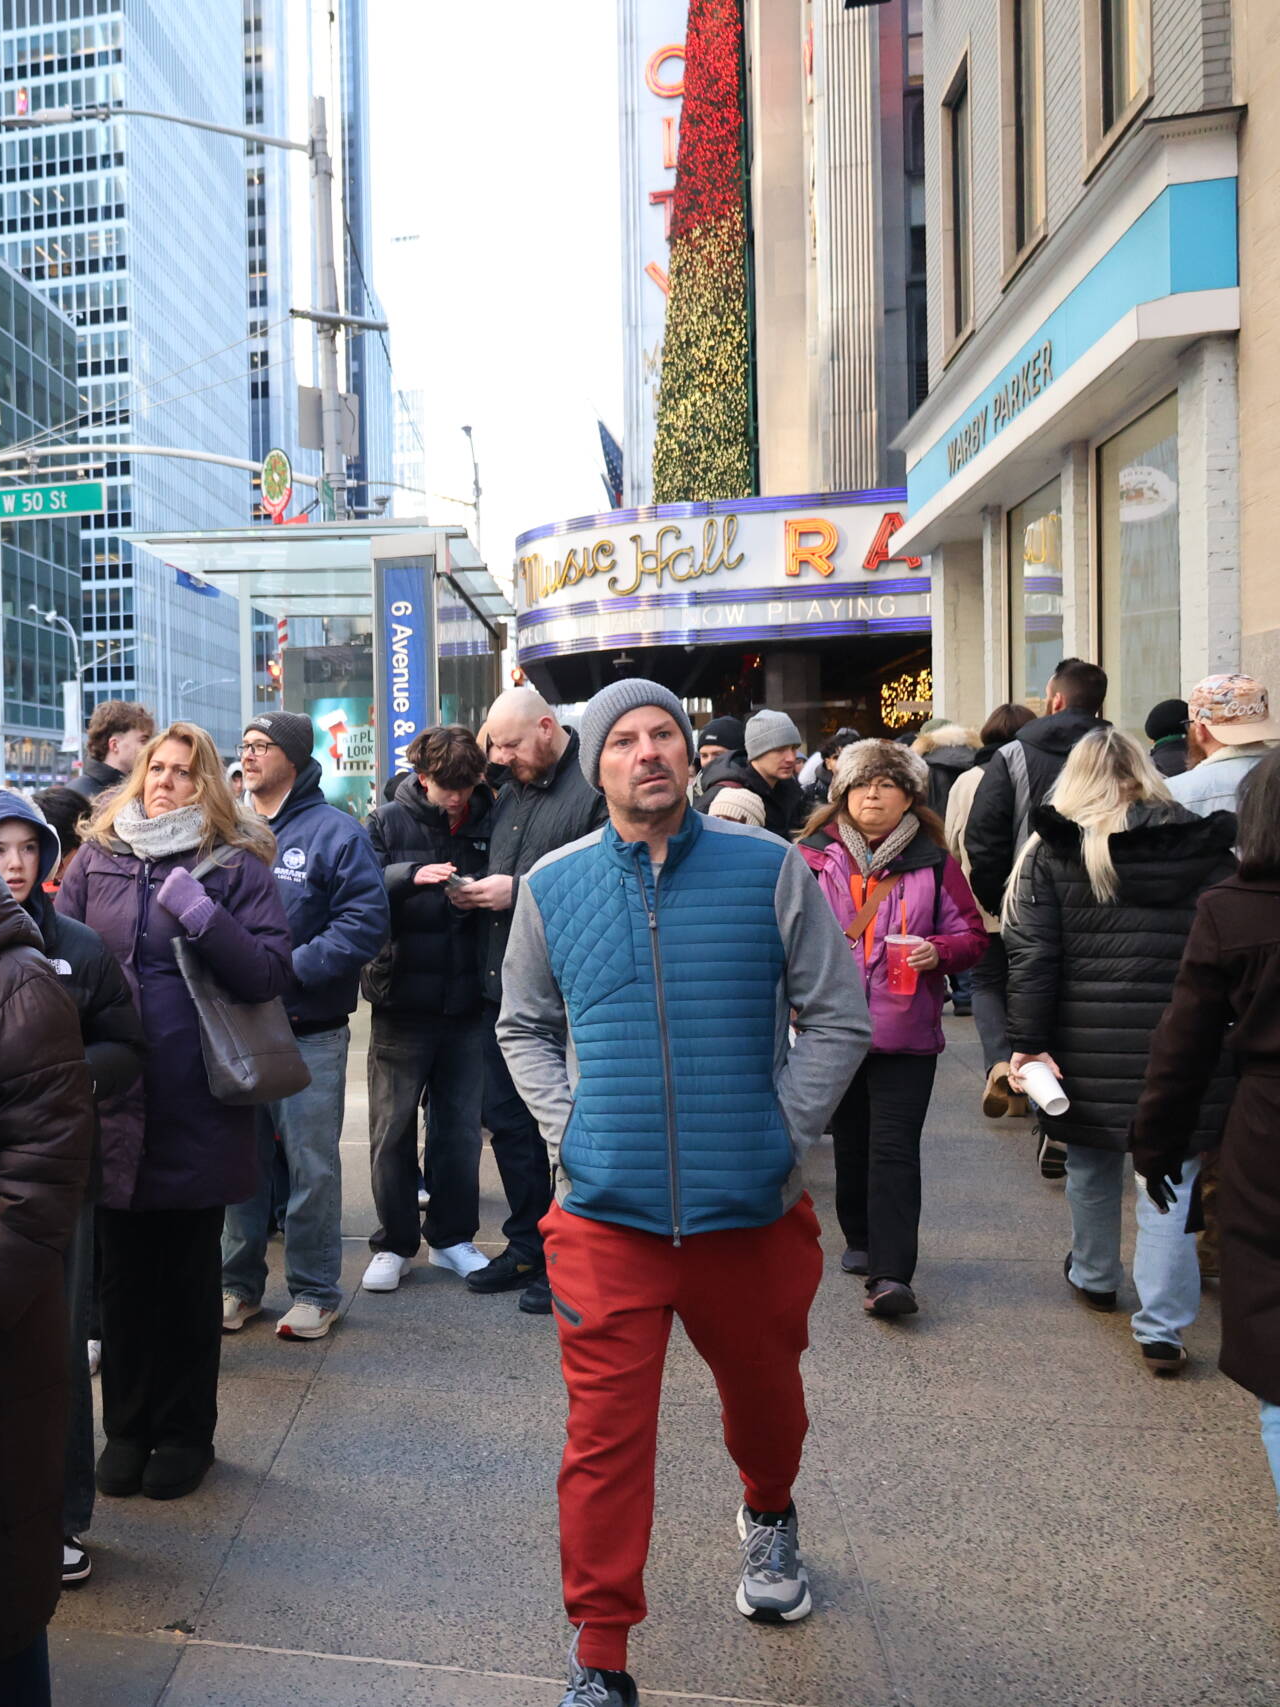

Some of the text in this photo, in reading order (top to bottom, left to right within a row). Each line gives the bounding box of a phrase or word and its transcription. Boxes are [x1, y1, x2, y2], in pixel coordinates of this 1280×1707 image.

[947, 340, 1053, 477] WARBY PARKER
[2, 490, 68, 513] W 50 St
[521, 514, 744, 607] Music Hall
[391, 601, 413, 617] 6
[768, 595, 896, 622] PLAYING
[392, 623, 414, 713] Avenue
[394, 719, 416, 738] &
[347, 745, 374, 759] LOOK
